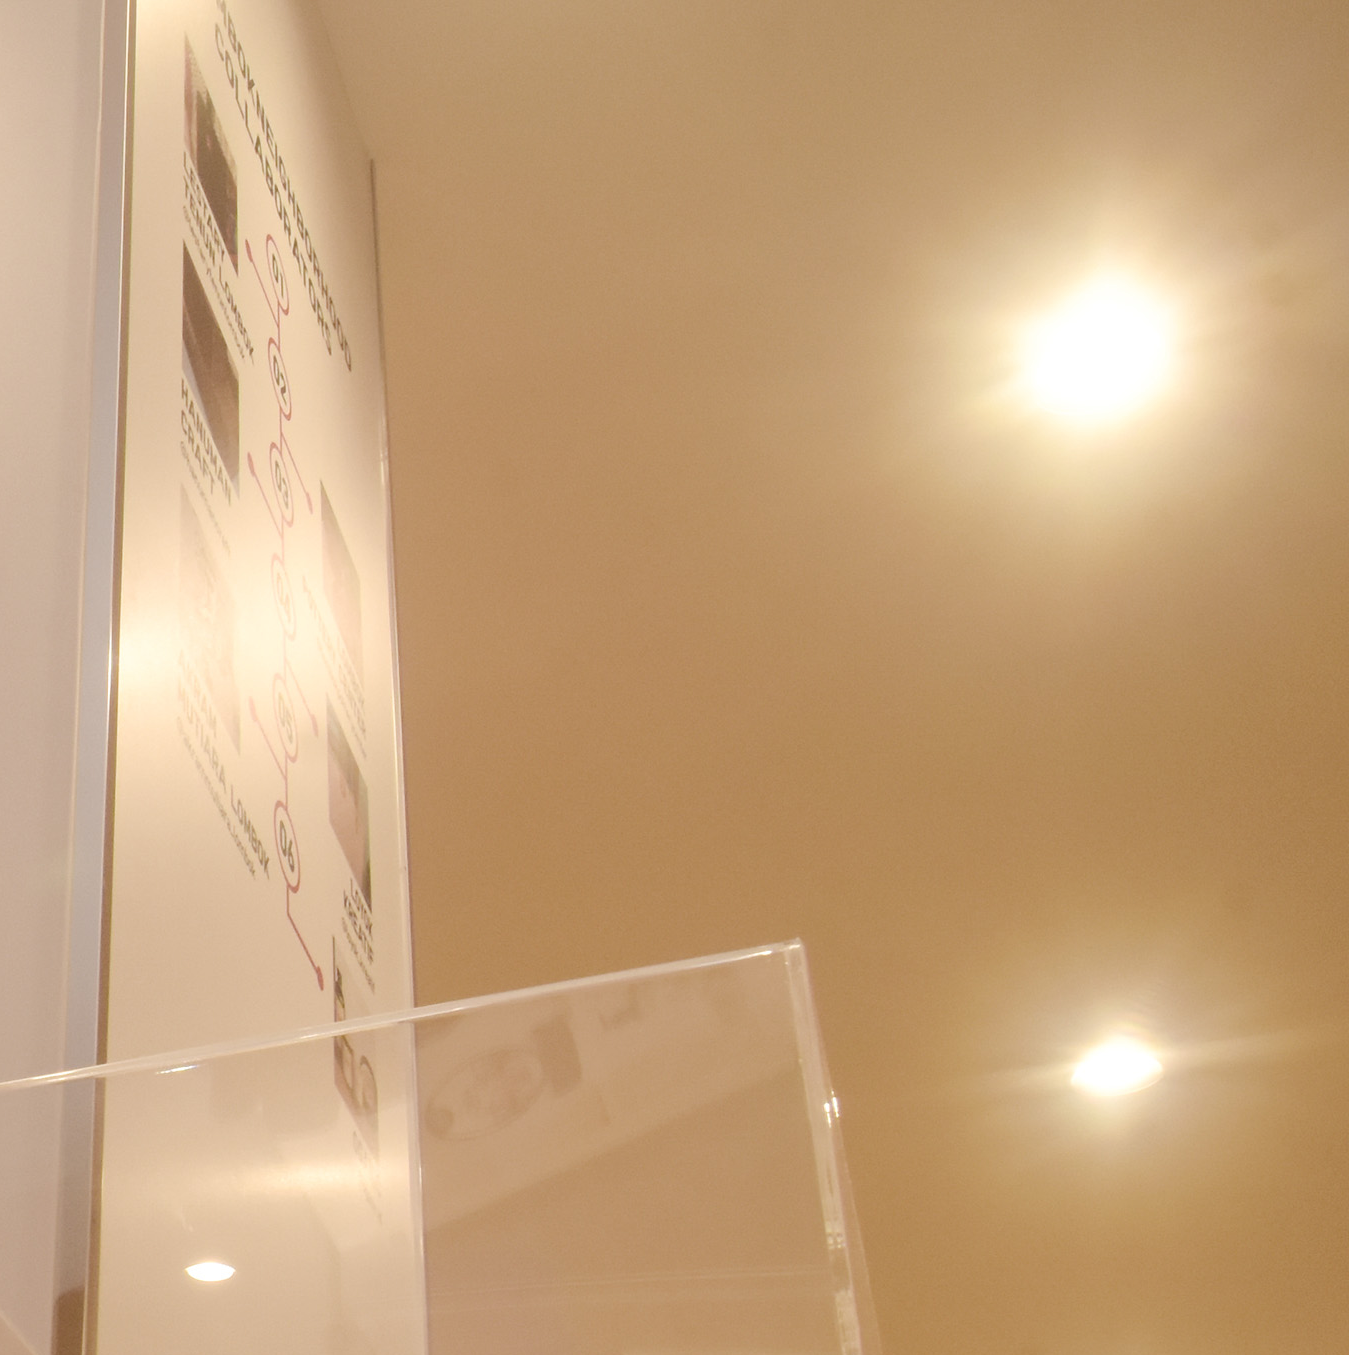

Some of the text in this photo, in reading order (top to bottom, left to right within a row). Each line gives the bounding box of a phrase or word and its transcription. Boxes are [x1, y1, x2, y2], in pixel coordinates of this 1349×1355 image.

[215, 23, 332, 356] COLLABORATORS
[272, 253, 284, 300] 01
[274, 354, 287, 404] 02
[274, 460, 289, 510] 03
[279, 820, 295, 873] 06
